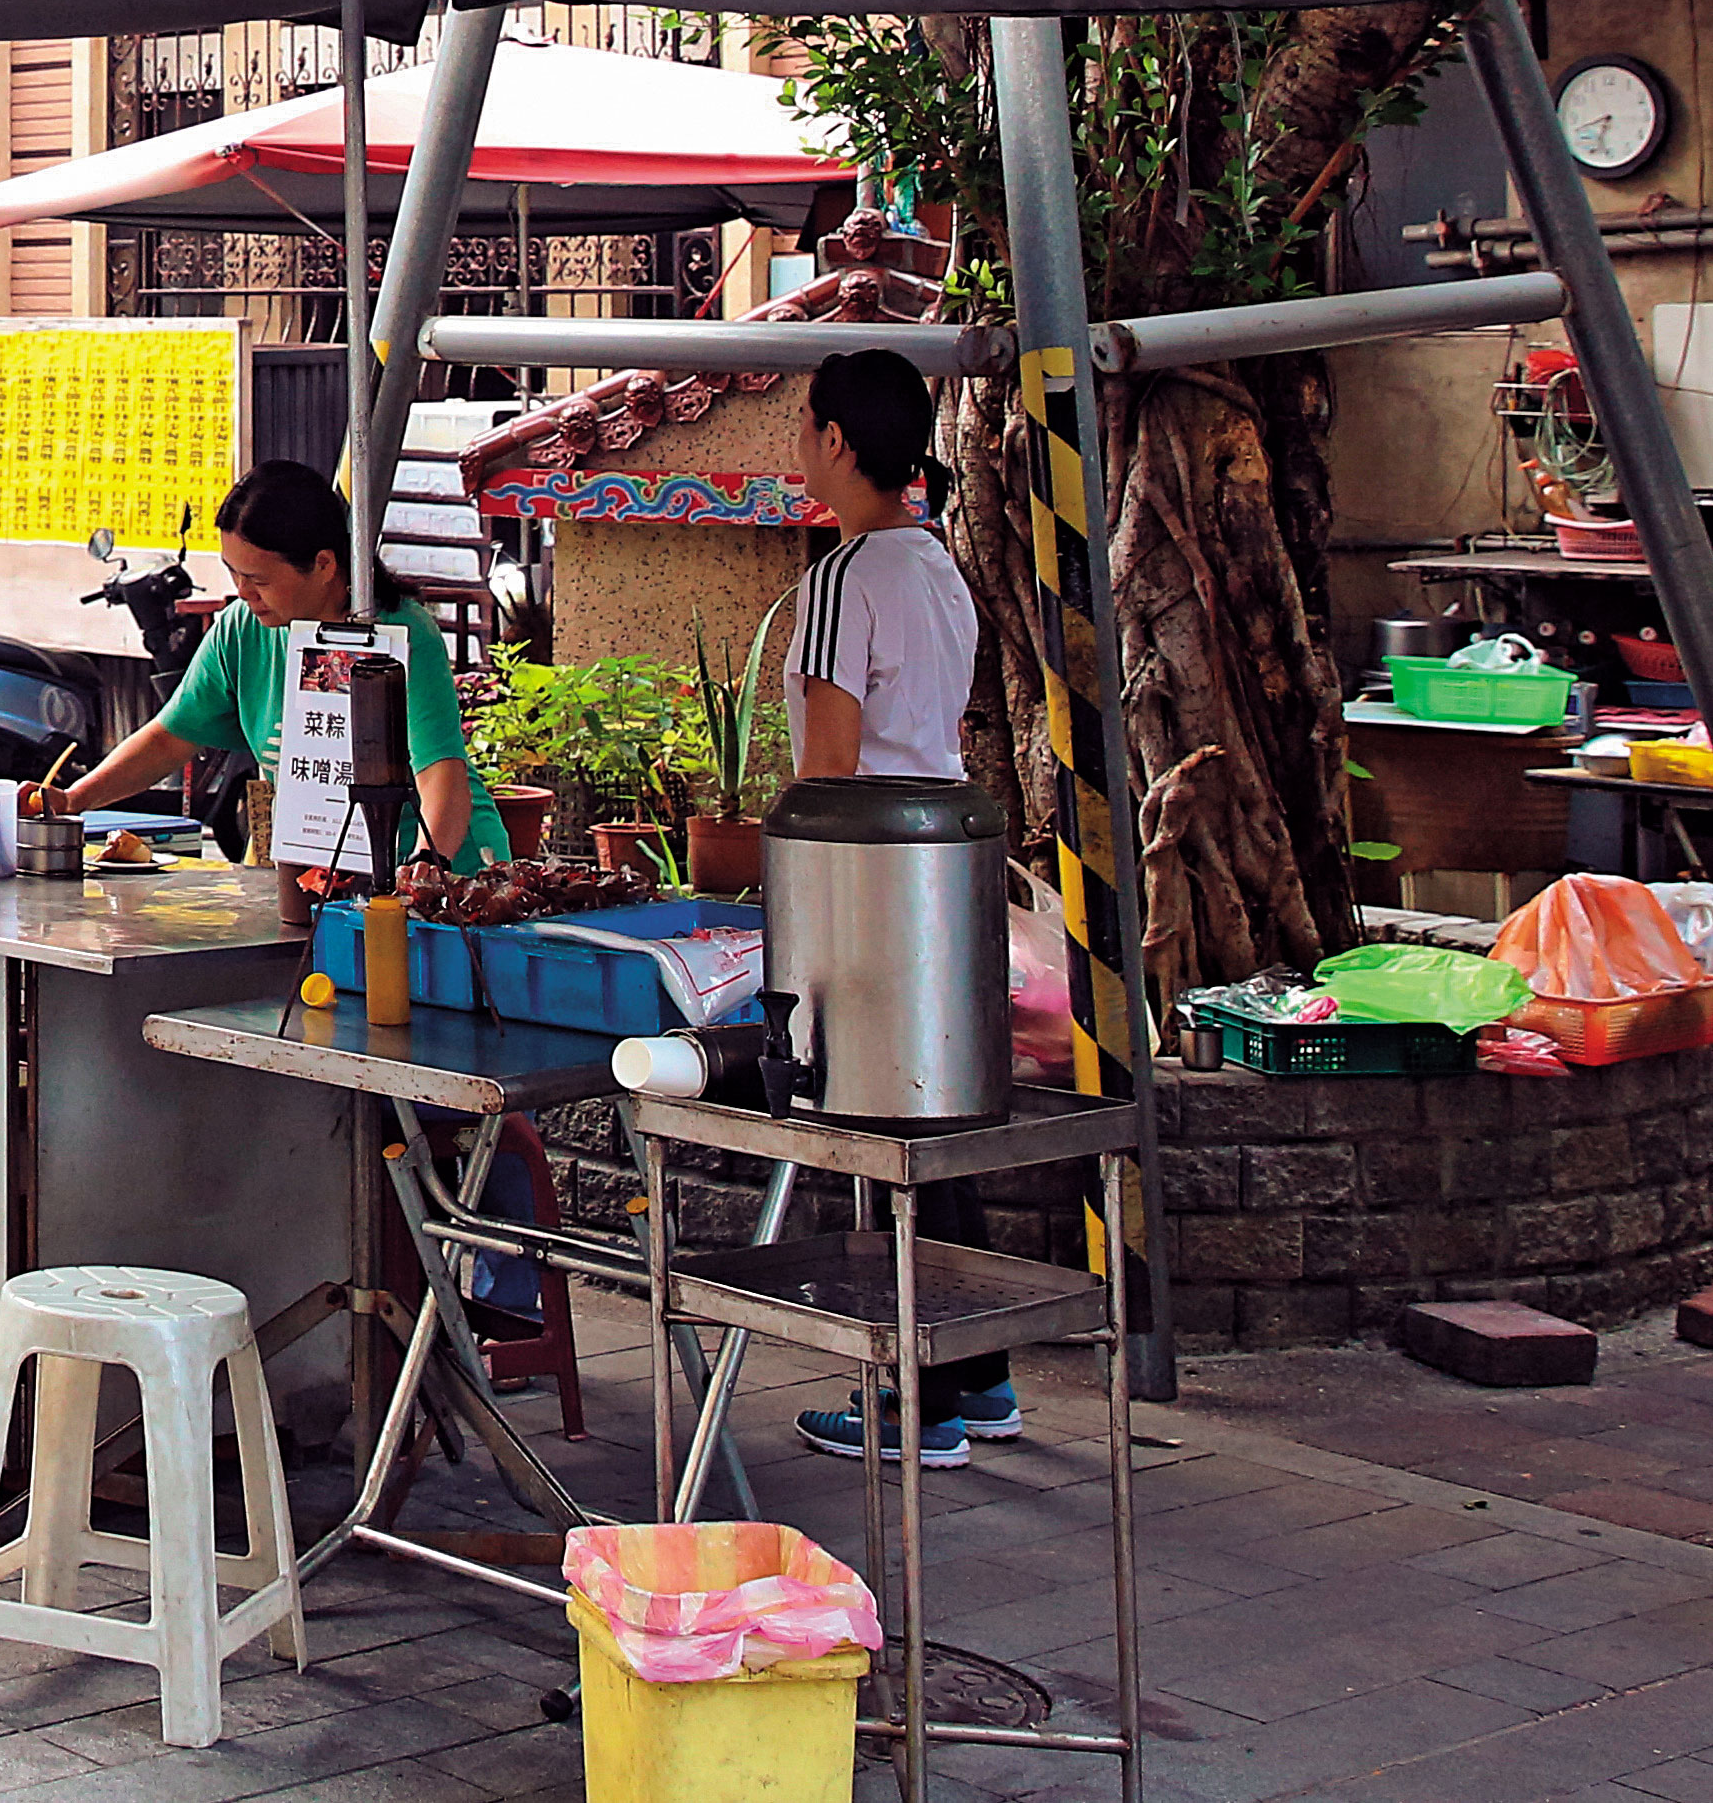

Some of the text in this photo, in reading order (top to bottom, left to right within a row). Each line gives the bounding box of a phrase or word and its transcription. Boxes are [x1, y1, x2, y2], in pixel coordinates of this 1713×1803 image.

[304, 711, 346, 739] 菜粽
[291, 756, 354, 786] 味噌湯
